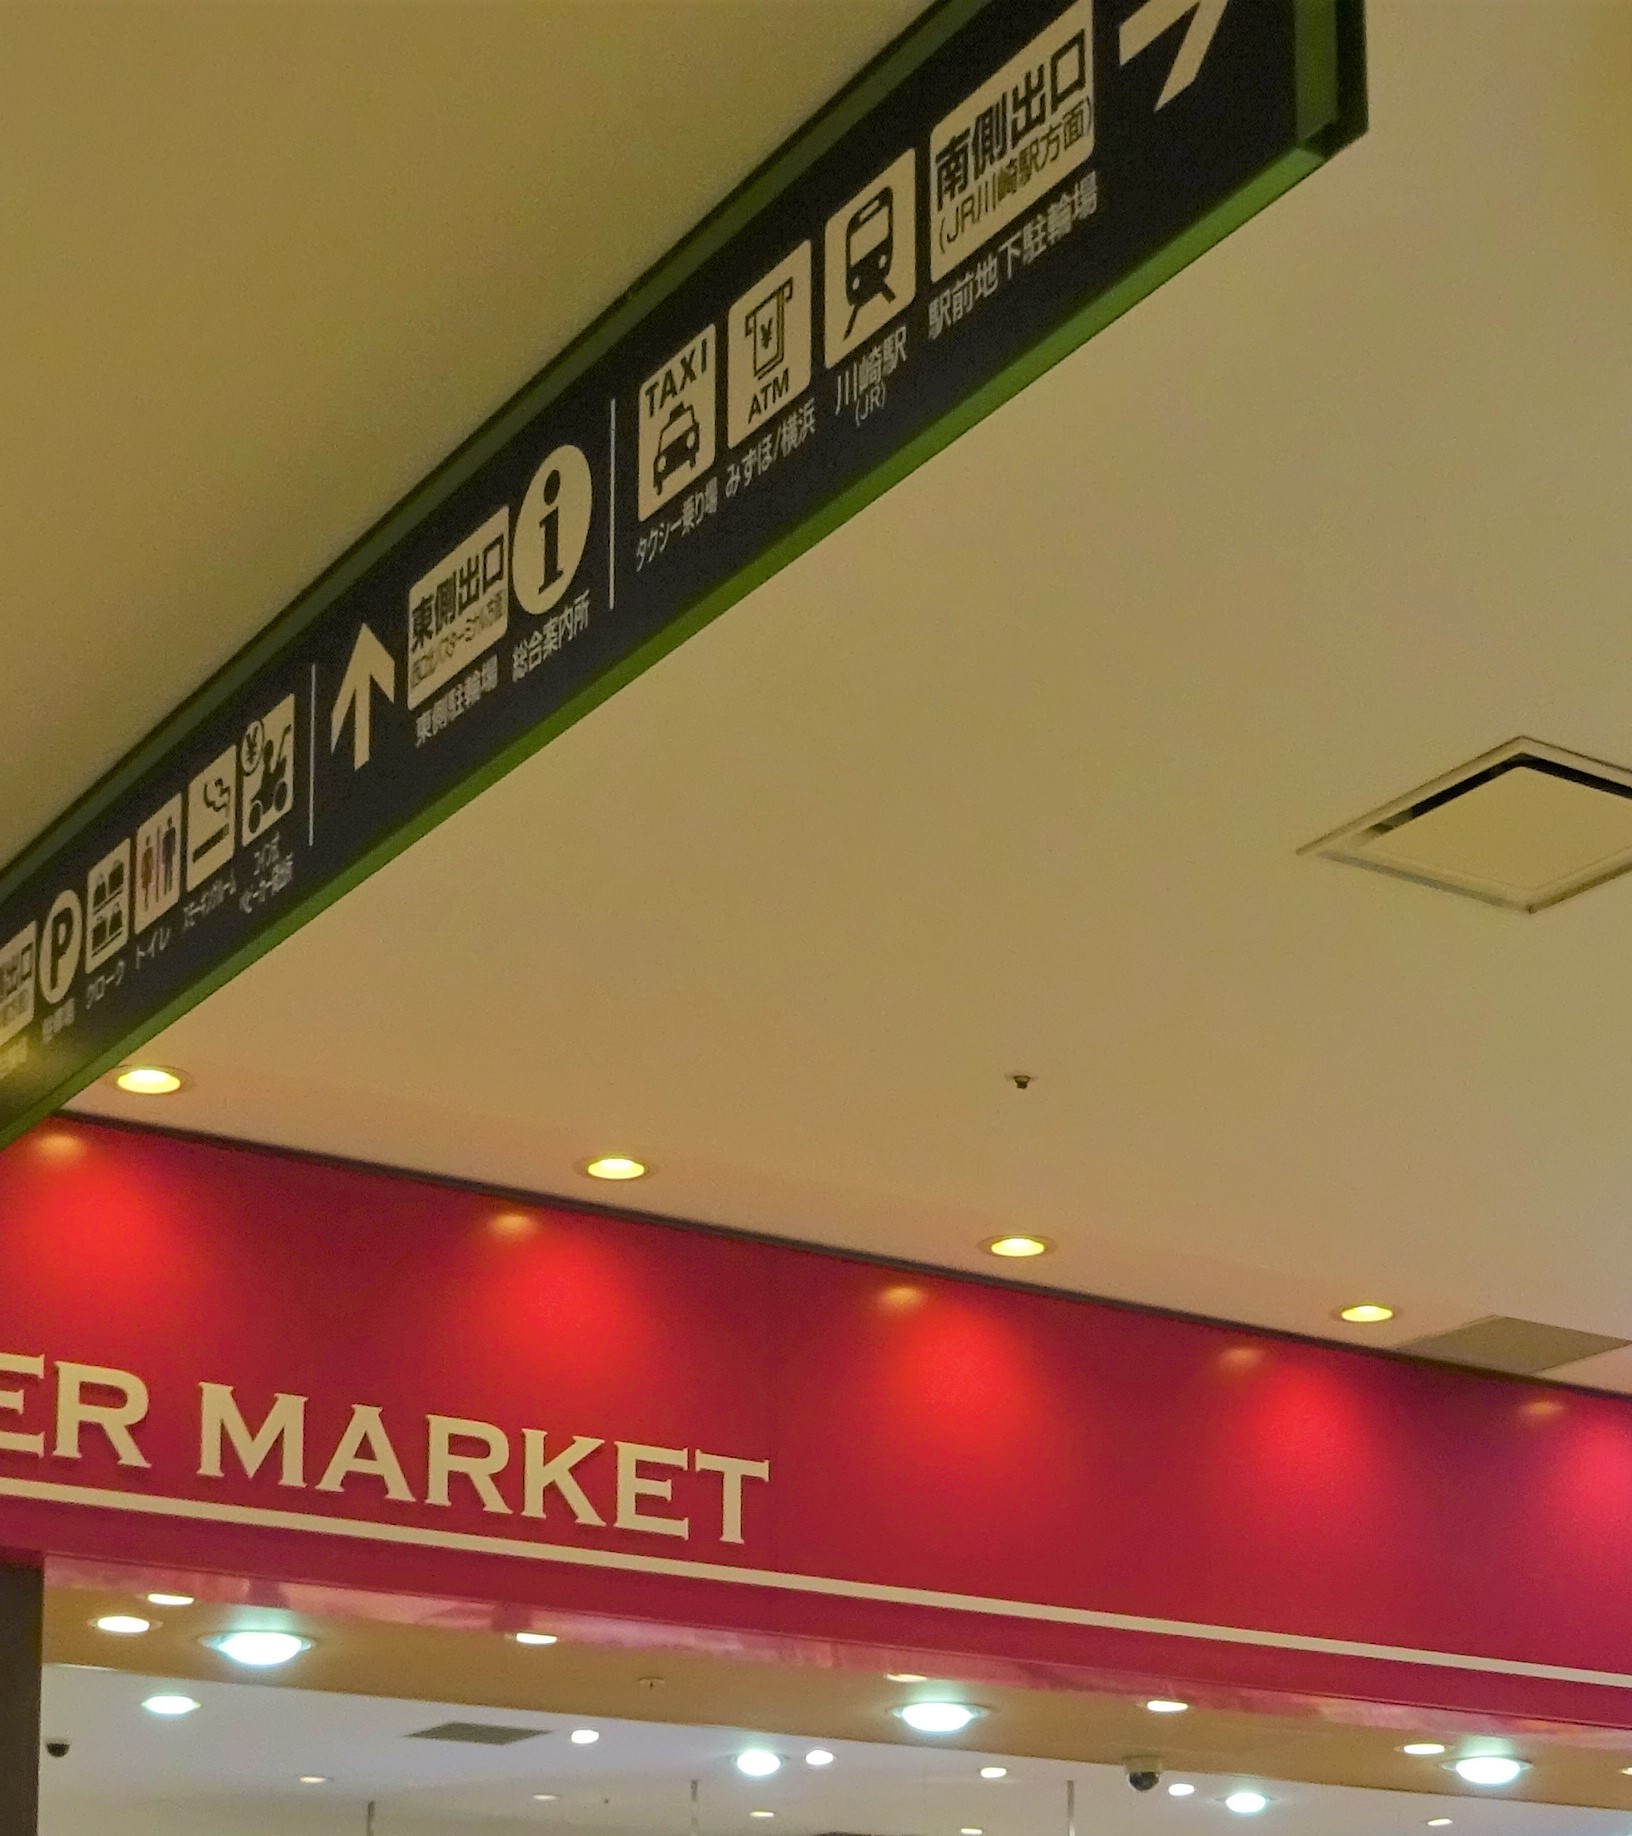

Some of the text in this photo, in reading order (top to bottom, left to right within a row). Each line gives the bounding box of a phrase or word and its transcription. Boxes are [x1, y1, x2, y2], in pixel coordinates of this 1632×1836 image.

[935, 28, 1088, 212] 南側出口
[939, 94, 1092, 255] (JR川崎駅方面)
[927, 172, 1099, 342] 駅前地下駐輪場
[644, 344, 708, 418] TAXI
[747, 373, 791, 425] ATM
[835, 325, 908, 417] 川崎駅
[855, 385, 887, 430] (JR)
[411, 533, 505, 652] 東側出口
[195, 1382, 770, 1546] MARKET
